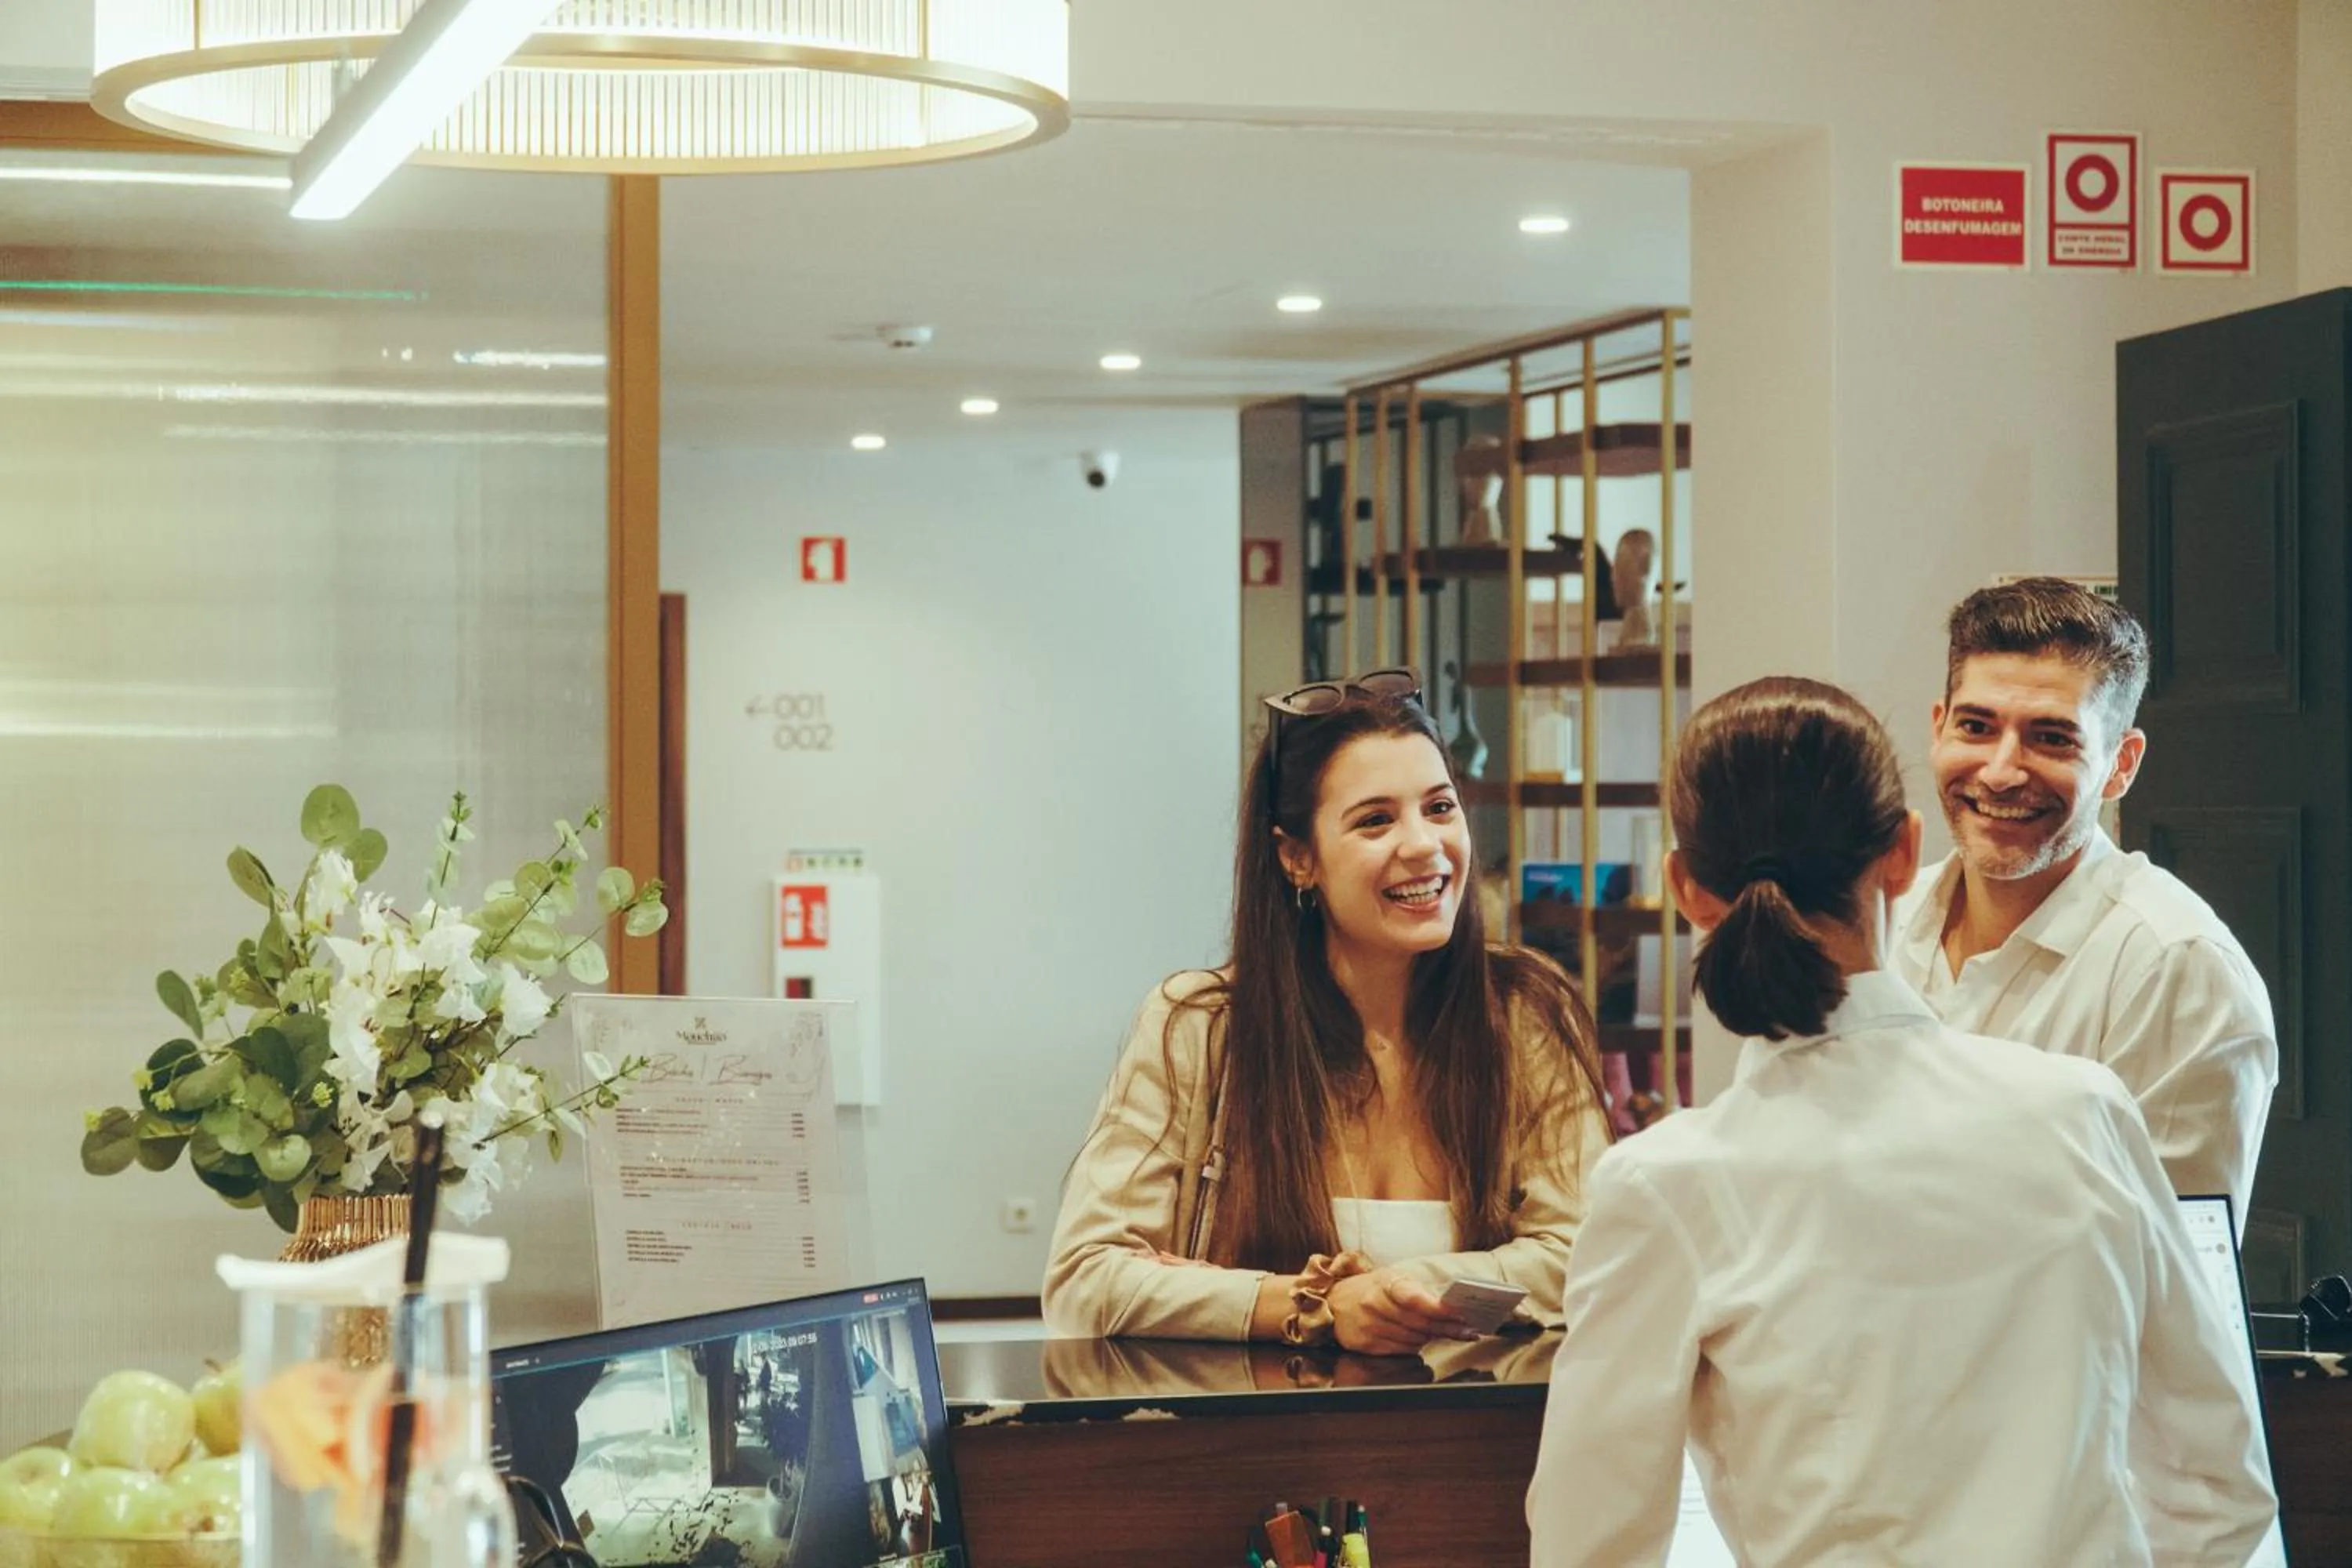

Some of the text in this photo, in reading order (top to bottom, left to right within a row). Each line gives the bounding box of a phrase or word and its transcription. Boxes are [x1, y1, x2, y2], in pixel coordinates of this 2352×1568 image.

[1922, 198, 2004, 213] BOTONEIRA
[1904, 219, 2023, 236] DESENFUMAGEM
[773, 693, 825, 720] 001
[772, 723, 834, 750] 002
